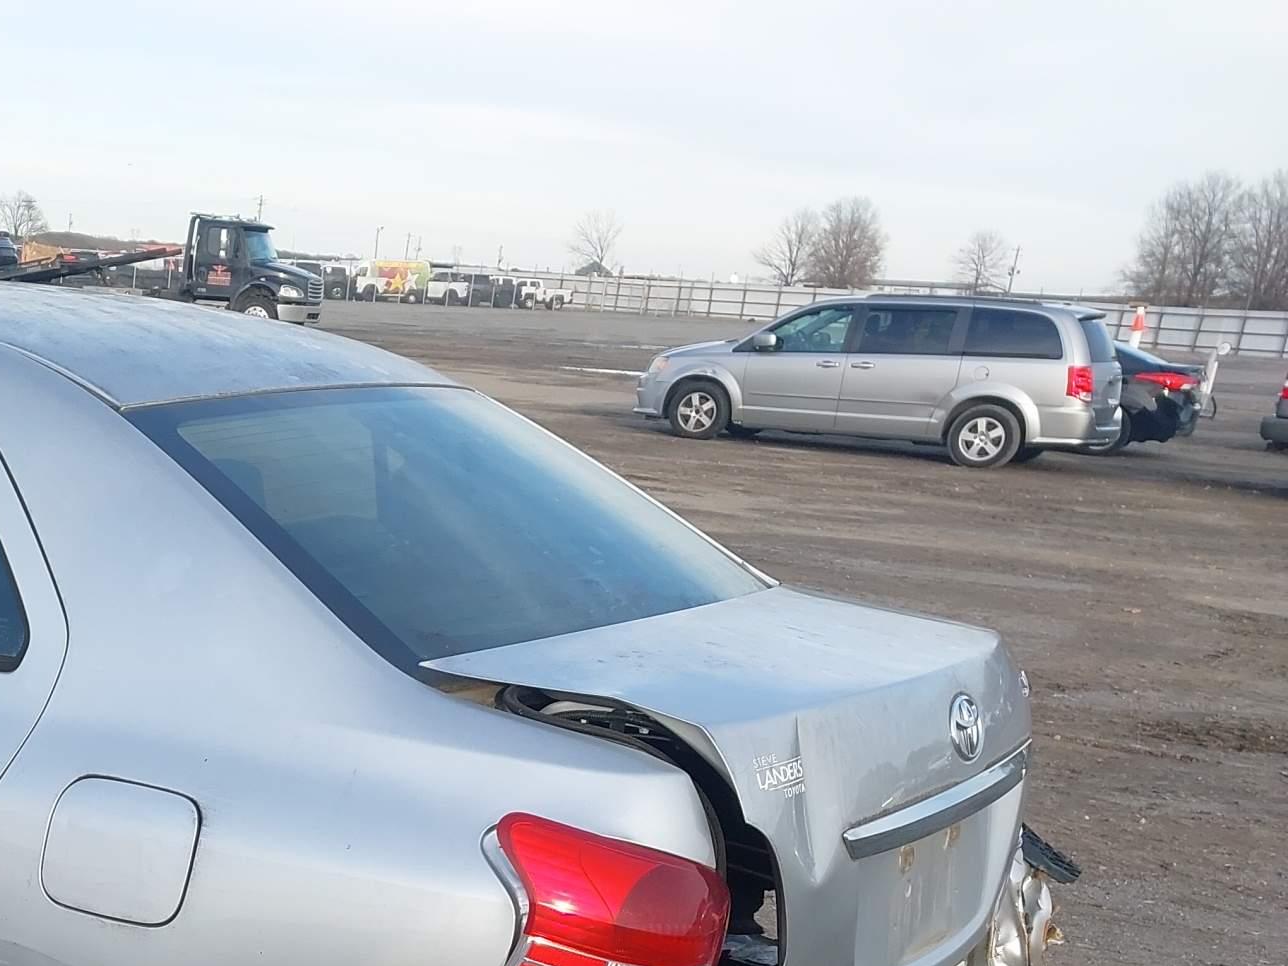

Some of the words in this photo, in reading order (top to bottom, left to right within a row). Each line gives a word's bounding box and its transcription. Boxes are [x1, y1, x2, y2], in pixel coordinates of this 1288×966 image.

[753, 753, 778, 769] STEVE
[756, 760, 803, 790] LANDERS
[784, 783, 805, 798] TOYOTA
